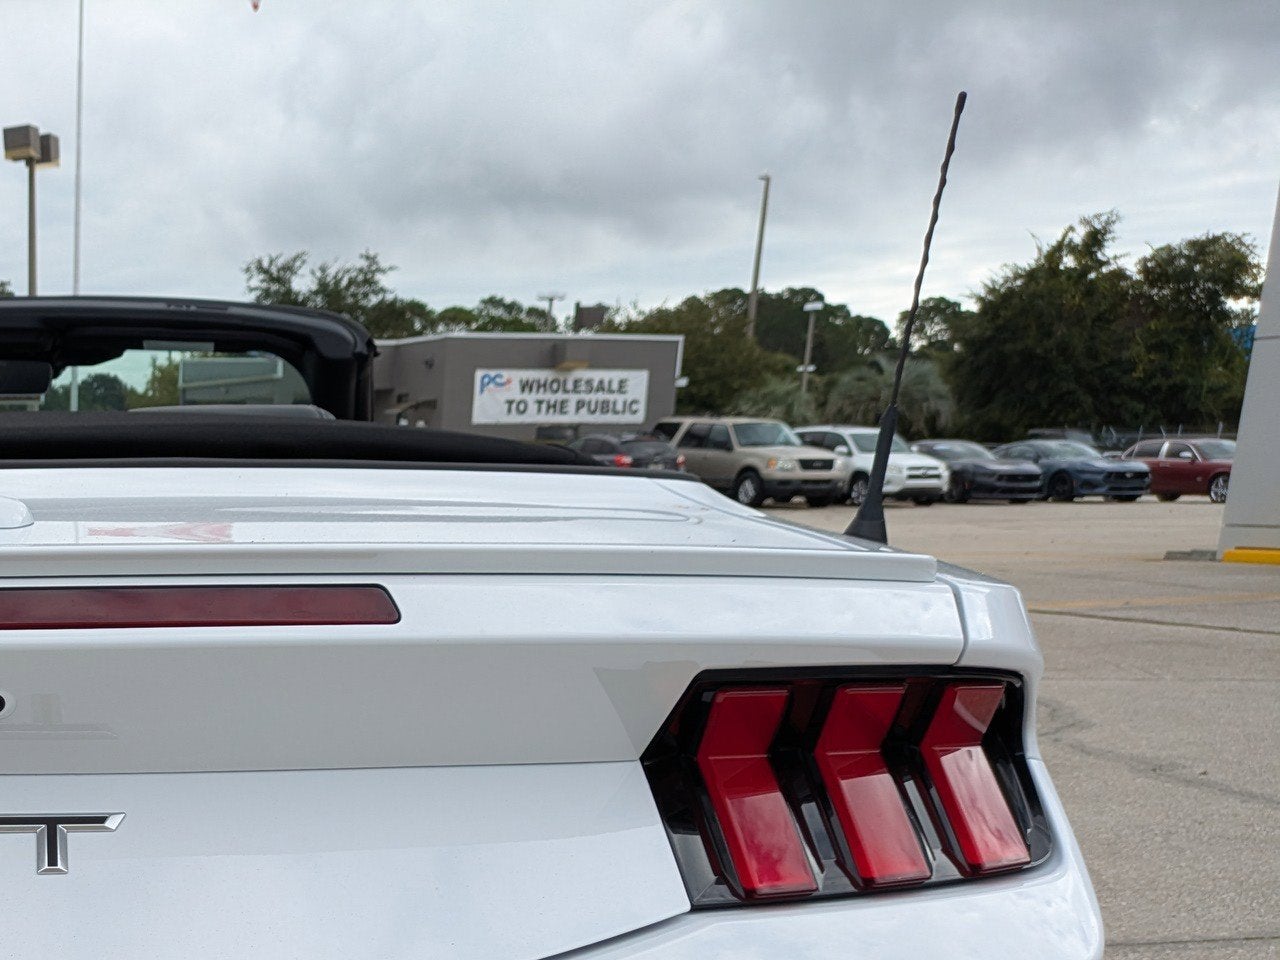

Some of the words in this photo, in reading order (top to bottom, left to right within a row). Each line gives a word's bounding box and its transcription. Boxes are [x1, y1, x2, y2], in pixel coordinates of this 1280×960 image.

[520, 378, 629, 394] WHOLESALE
[505, 399, 528, 415] TO
[535, 400, 569, 415] THE
[575, 400, 640, 415] PUBLIC
